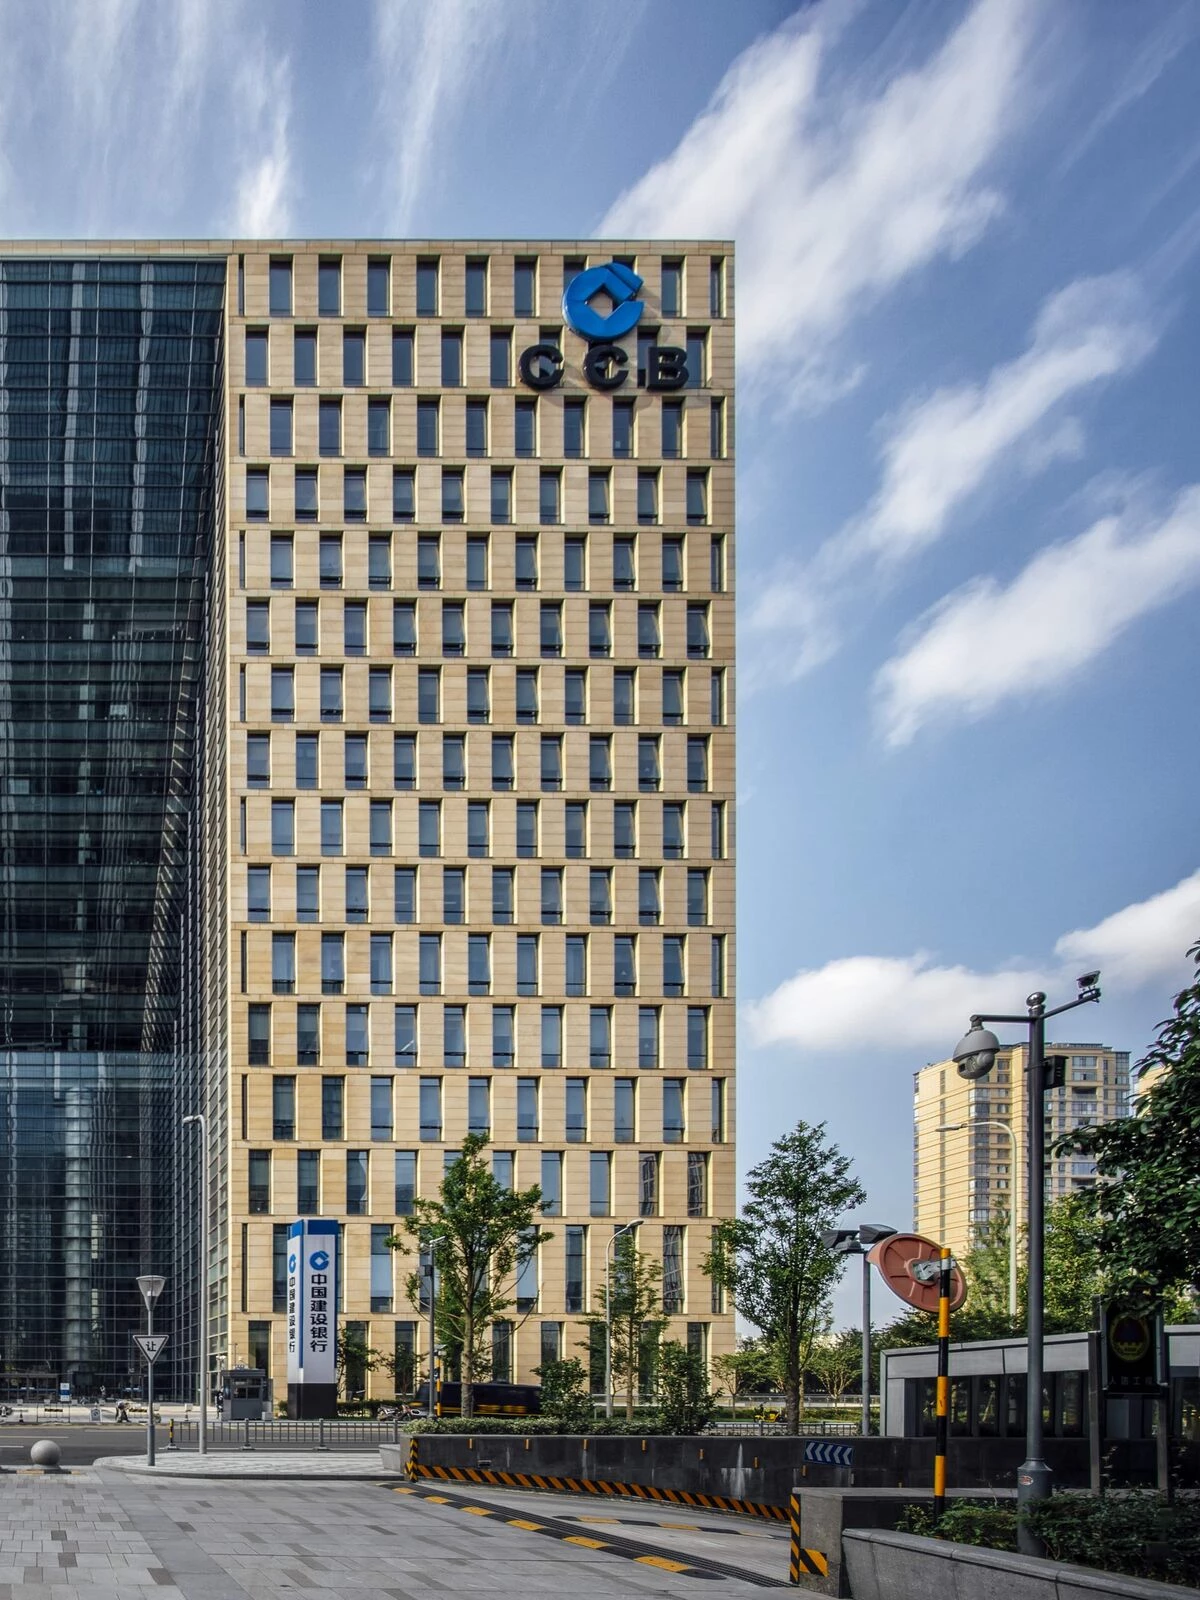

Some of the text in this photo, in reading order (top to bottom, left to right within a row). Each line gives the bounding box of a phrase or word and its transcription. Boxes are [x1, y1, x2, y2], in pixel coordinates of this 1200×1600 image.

[310, 1273, 328, 1353] 中国建设银行
[145, 1341, 157, 1352] 让
